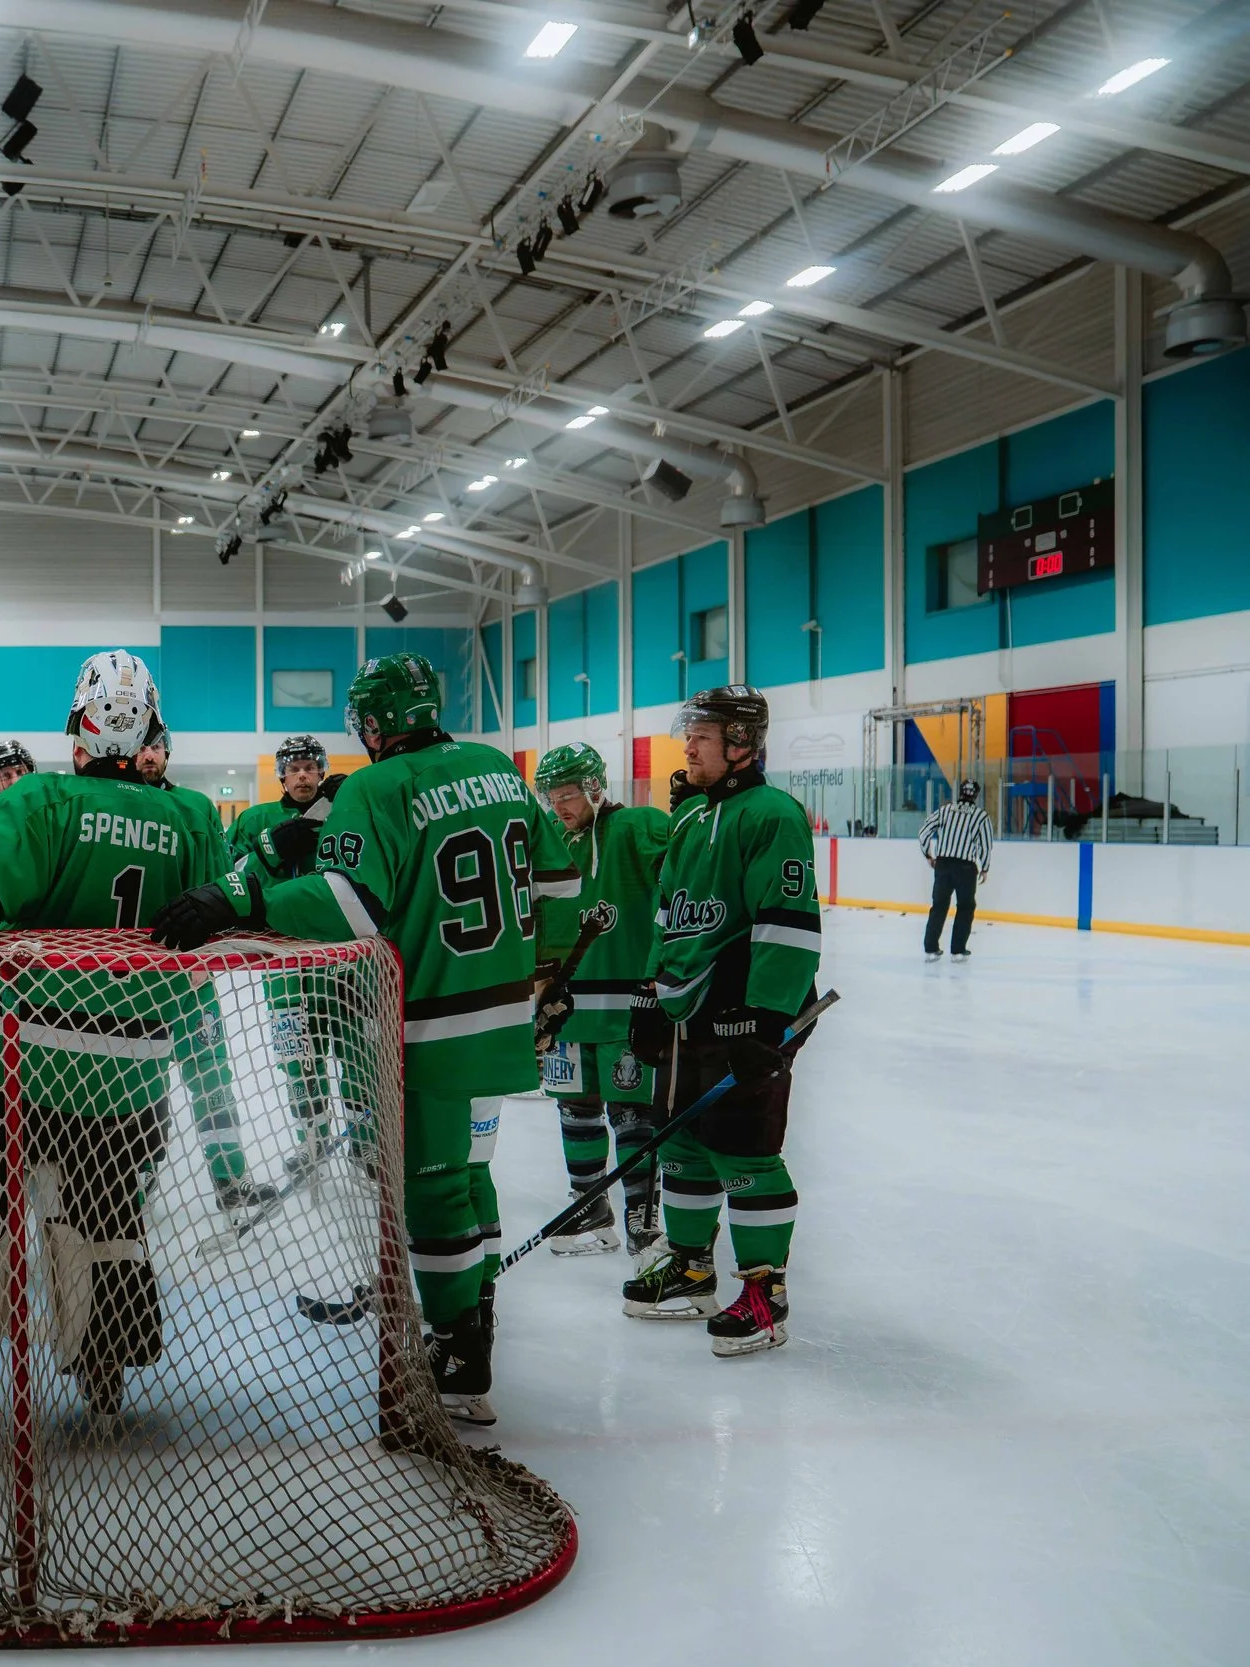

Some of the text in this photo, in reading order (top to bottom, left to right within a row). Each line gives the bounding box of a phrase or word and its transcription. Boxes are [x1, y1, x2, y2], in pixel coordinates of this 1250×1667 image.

[789, 769, 844, 787] IceSheffield
[110, 864, 145, 929] 1
[433, 818, 536, 957] 98
